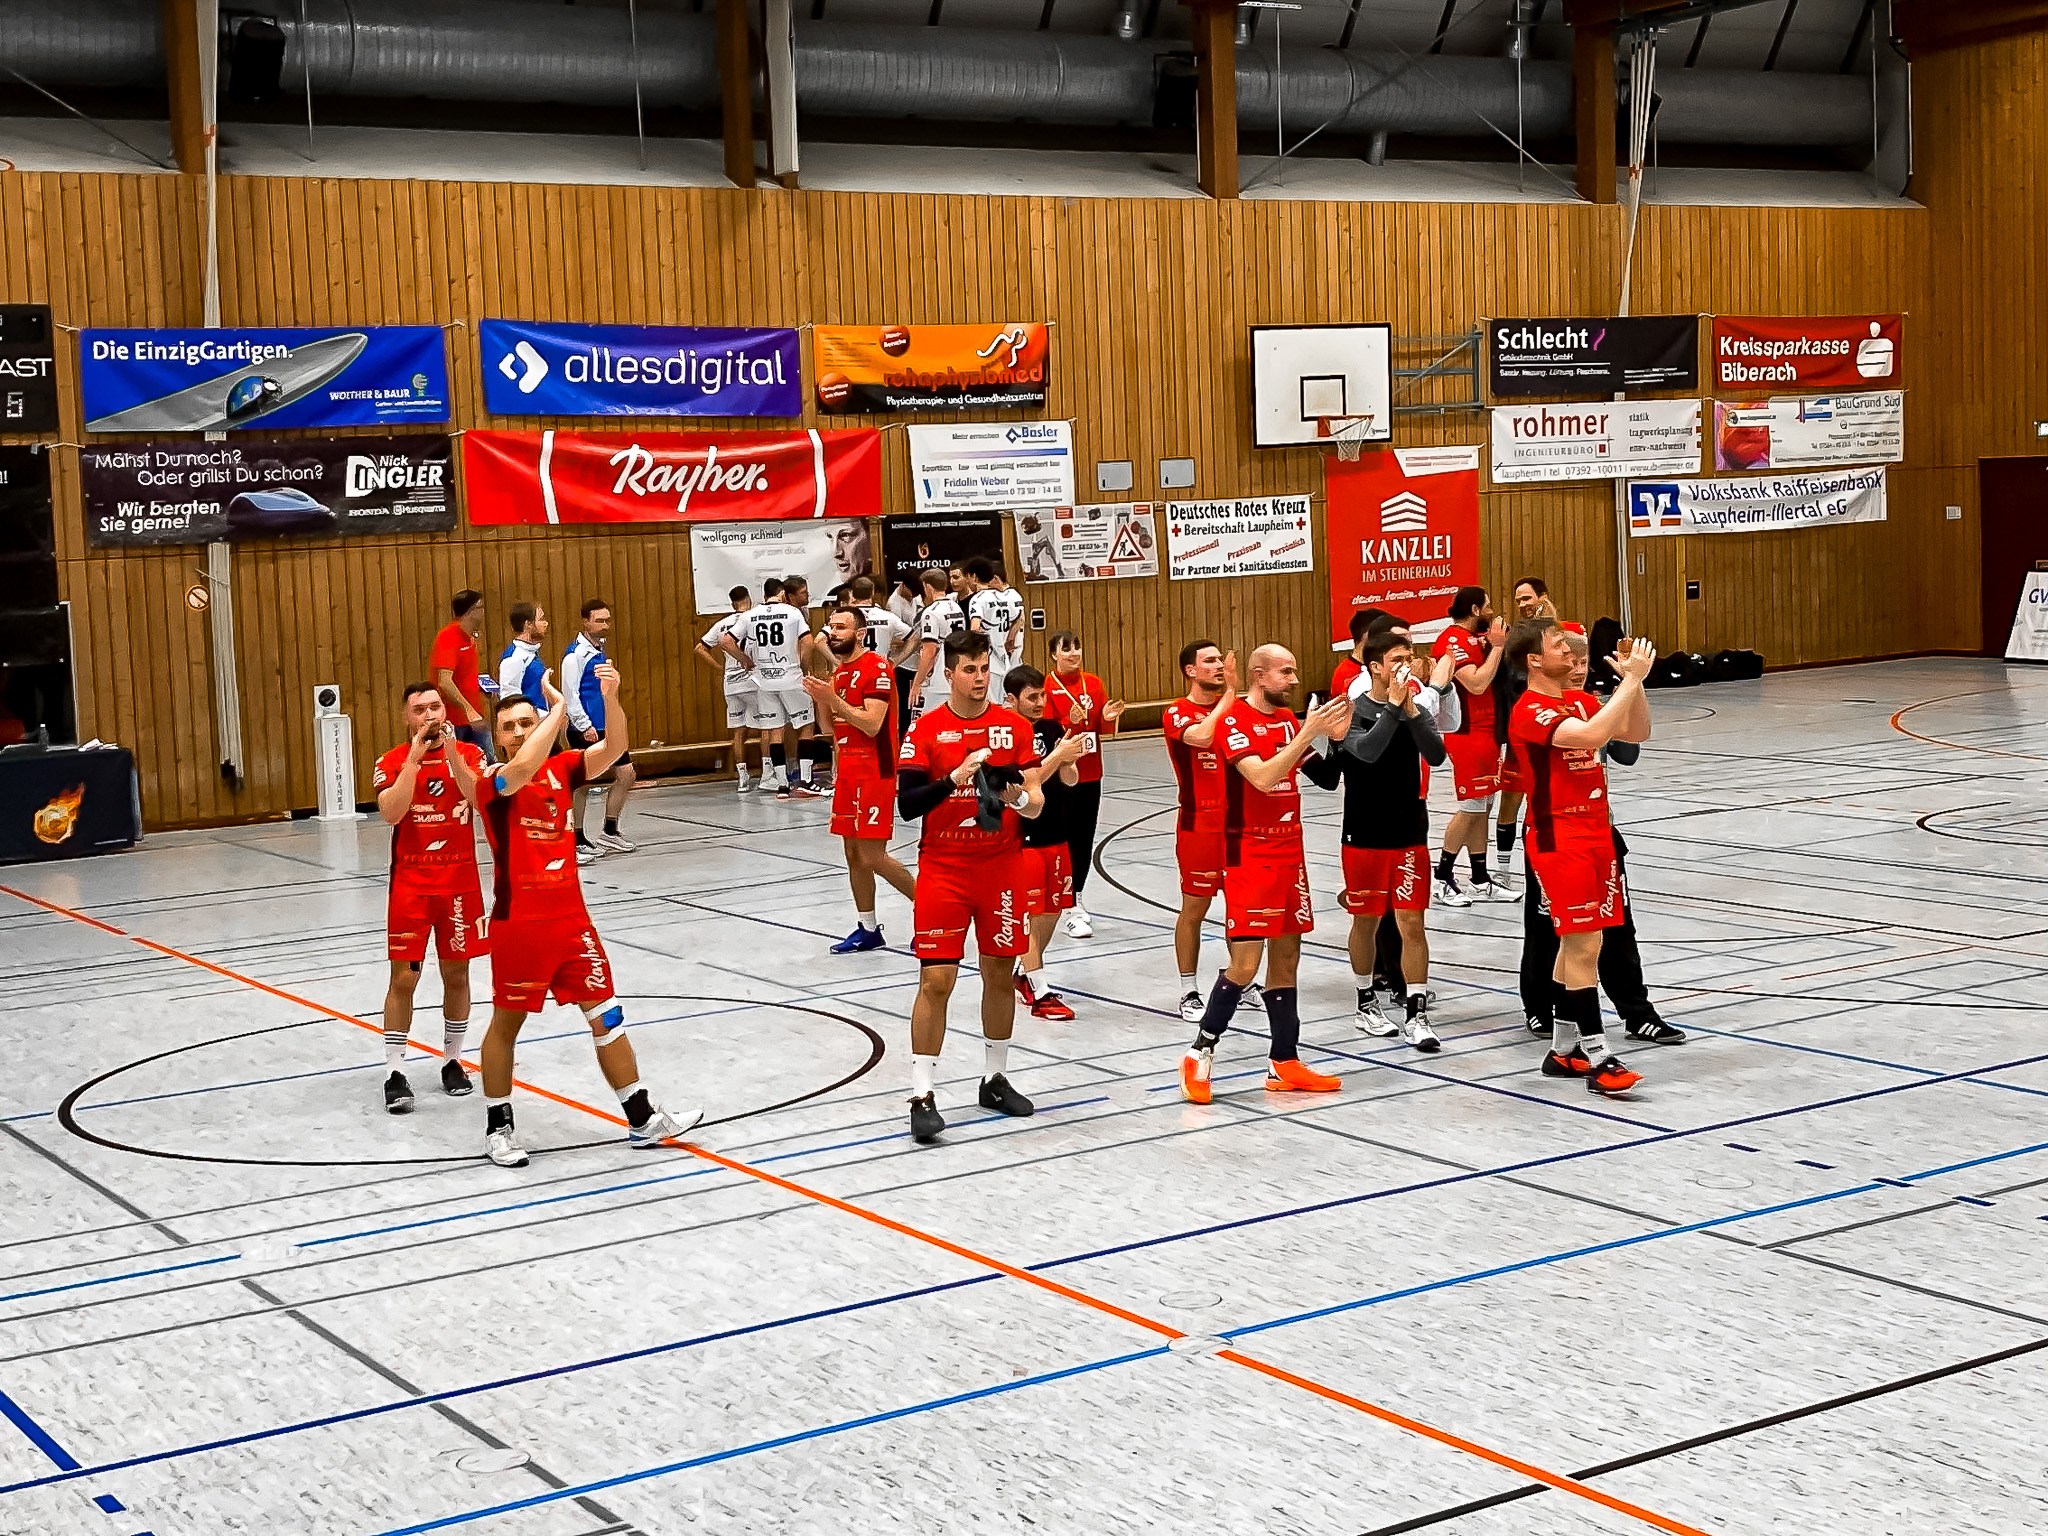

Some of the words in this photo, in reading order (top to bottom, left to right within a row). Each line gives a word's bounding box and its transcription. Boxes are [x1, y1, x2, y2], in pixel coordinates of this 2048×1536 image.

[1497, 326, 1589, 350] Schlecht
[1720, 333, 1851, 359] Kreissparkasse
[93, 341, 129, 360] Die
[135, 340, 294, 366] EinzigGartigen.
[563, 346, 788, 395] allesdigital
[1720, 361, 1798, 384] Biberach
[1836, 397, 1882, 410] BauGrund
[1021, 425, 1059, 438] Basler
[1512, 407, 1610, 438] rohmer
[94, 452, 151, 470] Mähst
[155, 451, 180, 467] Du
[186, 449, 242, 467] noch?
[379, 454, 409, 467] Nick
[1514, 445, 1594, 458] INGENIEURBÜRO
[137, 470, 185, 486] Oder
[189, 468, 231, 488] grillst
[235, 466, 260, 483] Du
[264, 464, 324, 482] schon?
[608, 442, 770, 514] Rayher.
[1565, 465, 1591, 476] 07392
[1687, 479, 1771, 502] Volksbank
[1773, 469, 1883, 499] Raiffeisenbank
[117, 501, 145, 517] Wir
[149, 500, 221, 516] beraten
[1170, 502, 1231, 521] Deutsches
[1234, 501, 1268, 518] Rotes
[1272, 499, 1307, 516] Kreuz
[1690, 499, 1822, 529] Laupheim-Illertal
[1826, 498, 1848, 516] eG
[99, 516, 126, 532] Sie
[131, 514, 191, 535] gerne!
[1184, 522, 1245, 536] Bereitschaft
[1247, 519, 1294, 535] Laupheim
[700, 530, 747, 545] wolfgang
[749, 528, 784, 542] schmid
[1360, 535, 1453, 565] KANZLEI
[1172, 565, 1186, 577] Ihr
[1187, 563, 1221, 575] Partner
[1223, 562, 1237, 573] bei
[1239, 559, 1308, 572] Sanitätsdiensten
[1361, 570, 1377, 583] IM
[1379, 563, 1452, 582] STEINERHAUS
[755, 621, 785, 647] 68
[850, 670, 861, 689] 2
[988, 725, 1015, 750] 55
[867, 806, 880, 825] 2
[993, 889, 1021, 948] Rayher.
